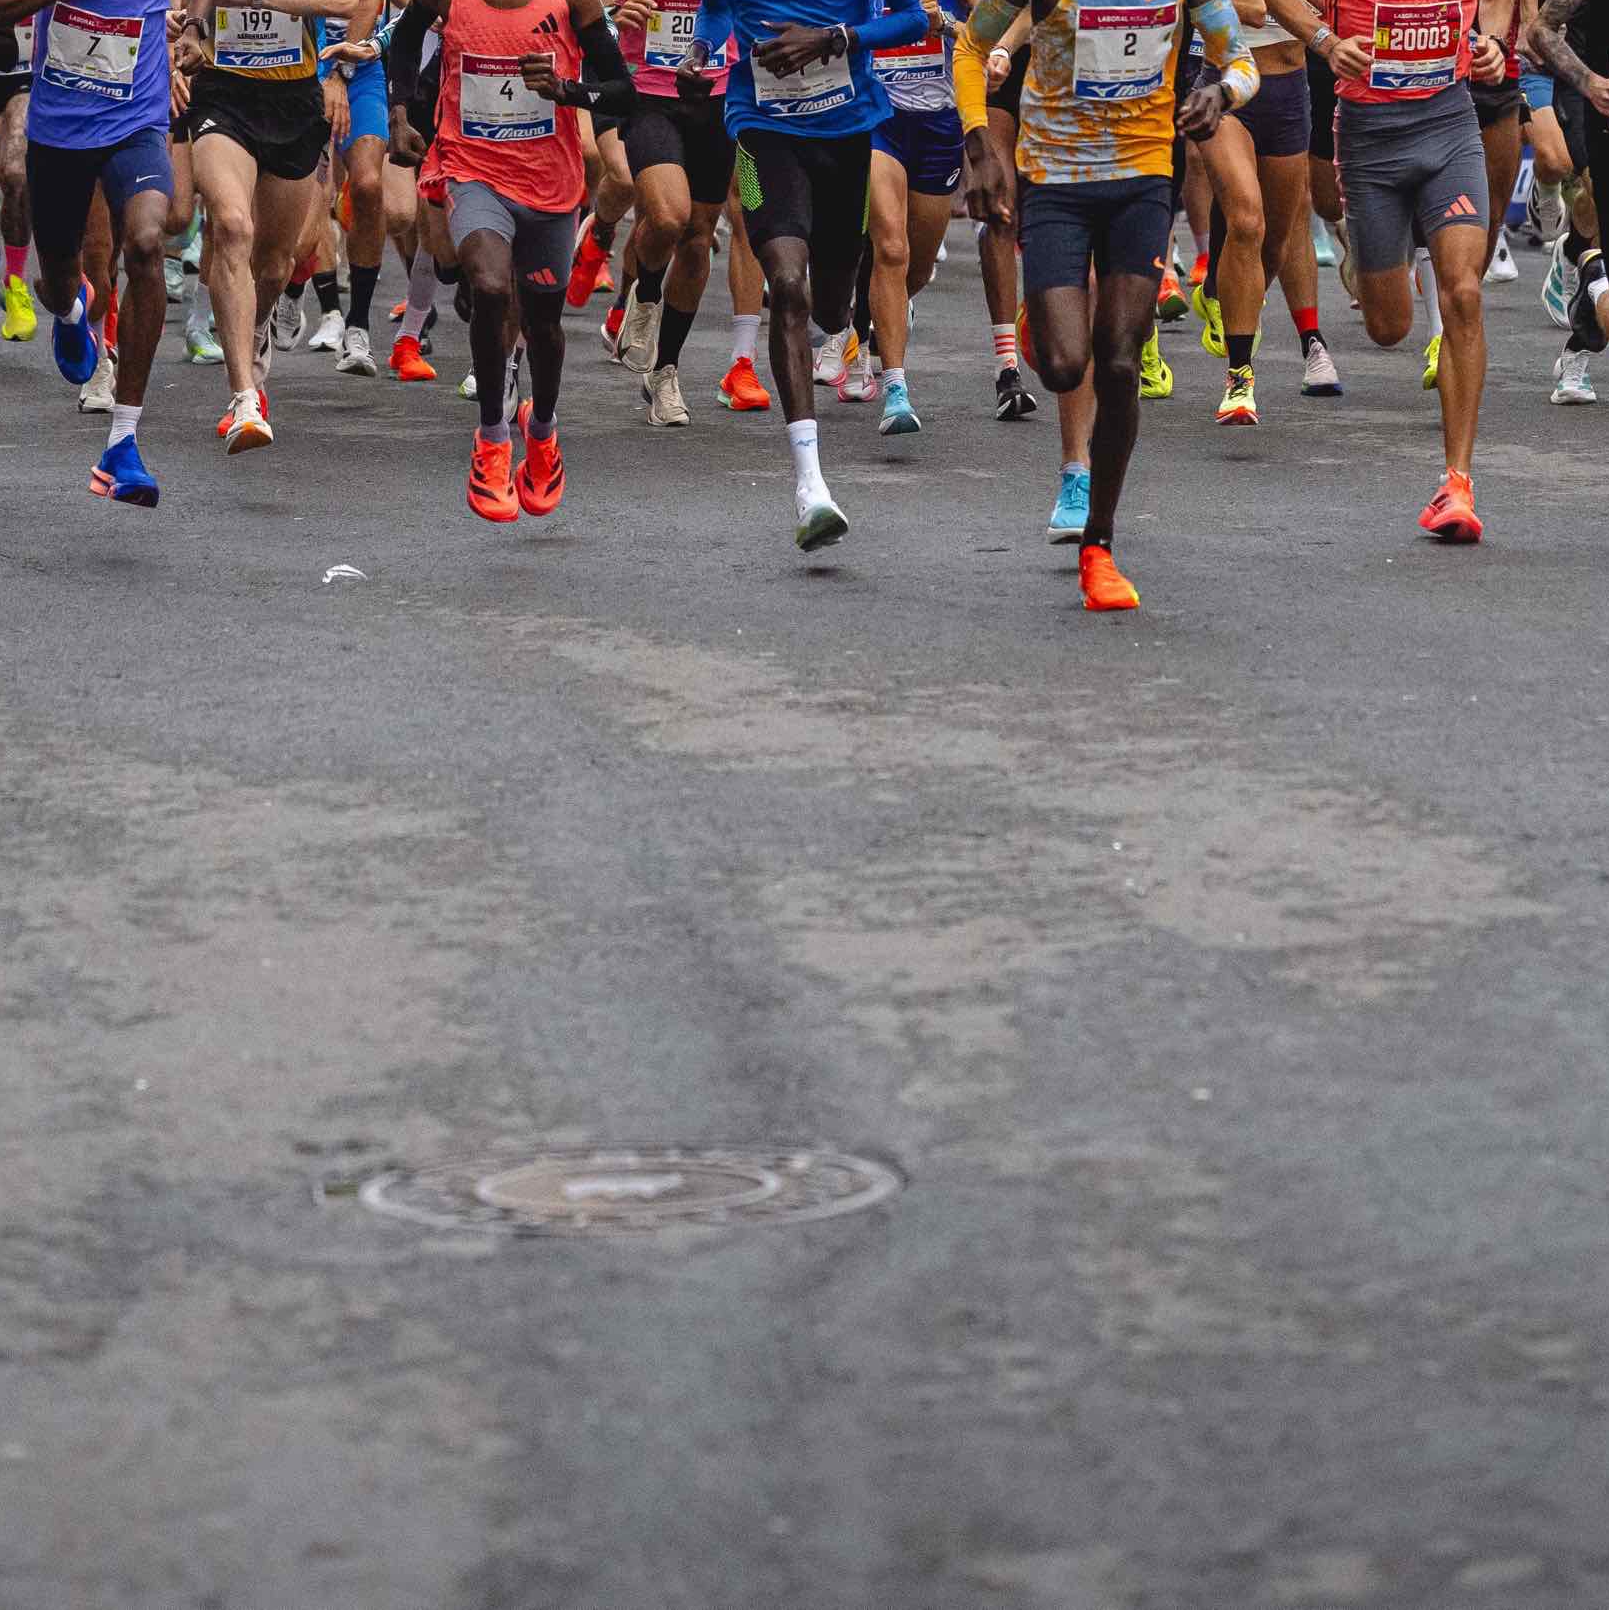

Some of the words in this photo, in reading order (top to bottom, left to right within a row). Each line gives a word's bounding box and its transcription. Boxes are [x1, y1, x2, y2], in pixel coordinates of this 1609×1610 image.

[241, 10, 273, 32] 199
[671, 15, 694, 35] 20
[86, 35, 102, 56] 7
[1123, 33, 1137, 56] 2
[1390, 25, 1450, 51] 20003
[499, 79, 514, 102] 4
